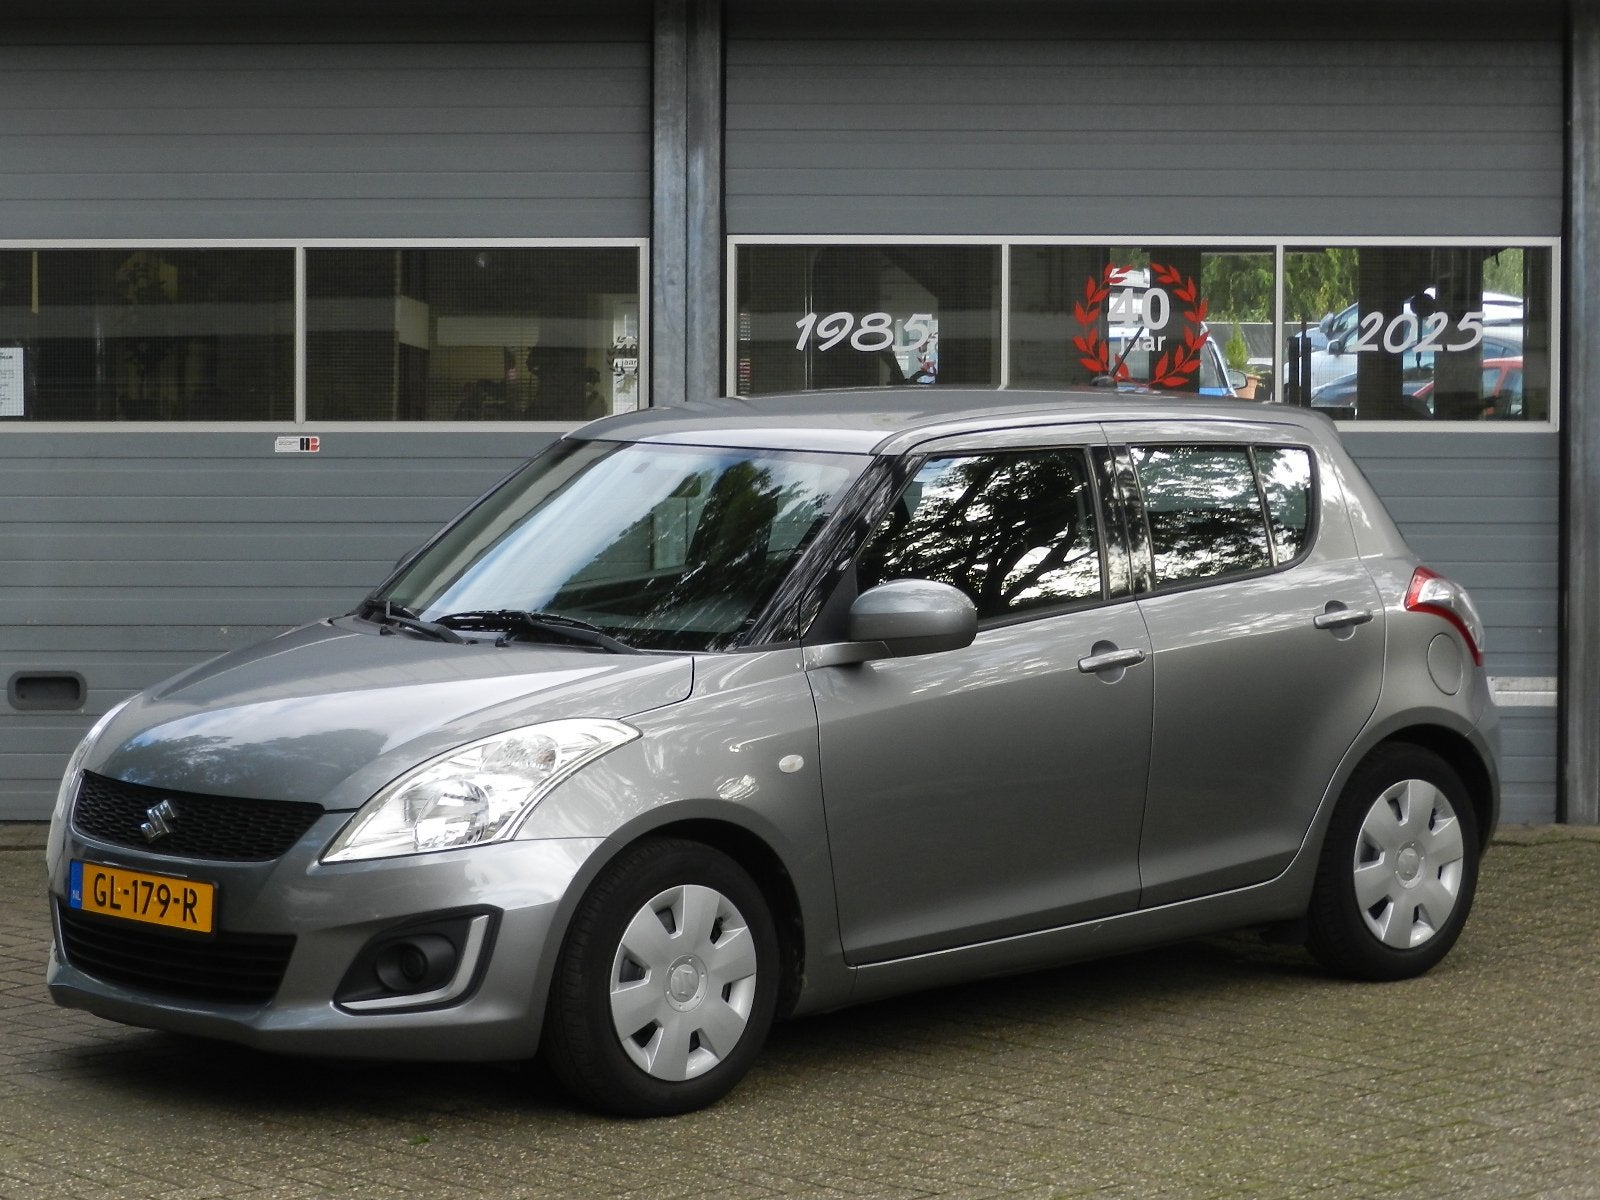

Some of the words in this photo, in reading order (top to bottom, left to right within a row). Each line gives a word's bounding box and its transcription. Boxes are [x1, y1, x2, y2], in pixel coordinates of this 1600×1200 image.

[1107, 288, 1170, 330] 40
[796, 312, 933, 352] 1985
[1351, 311, 1486, 354] 2025
[93, 873, 198, 924] GL-179-R
